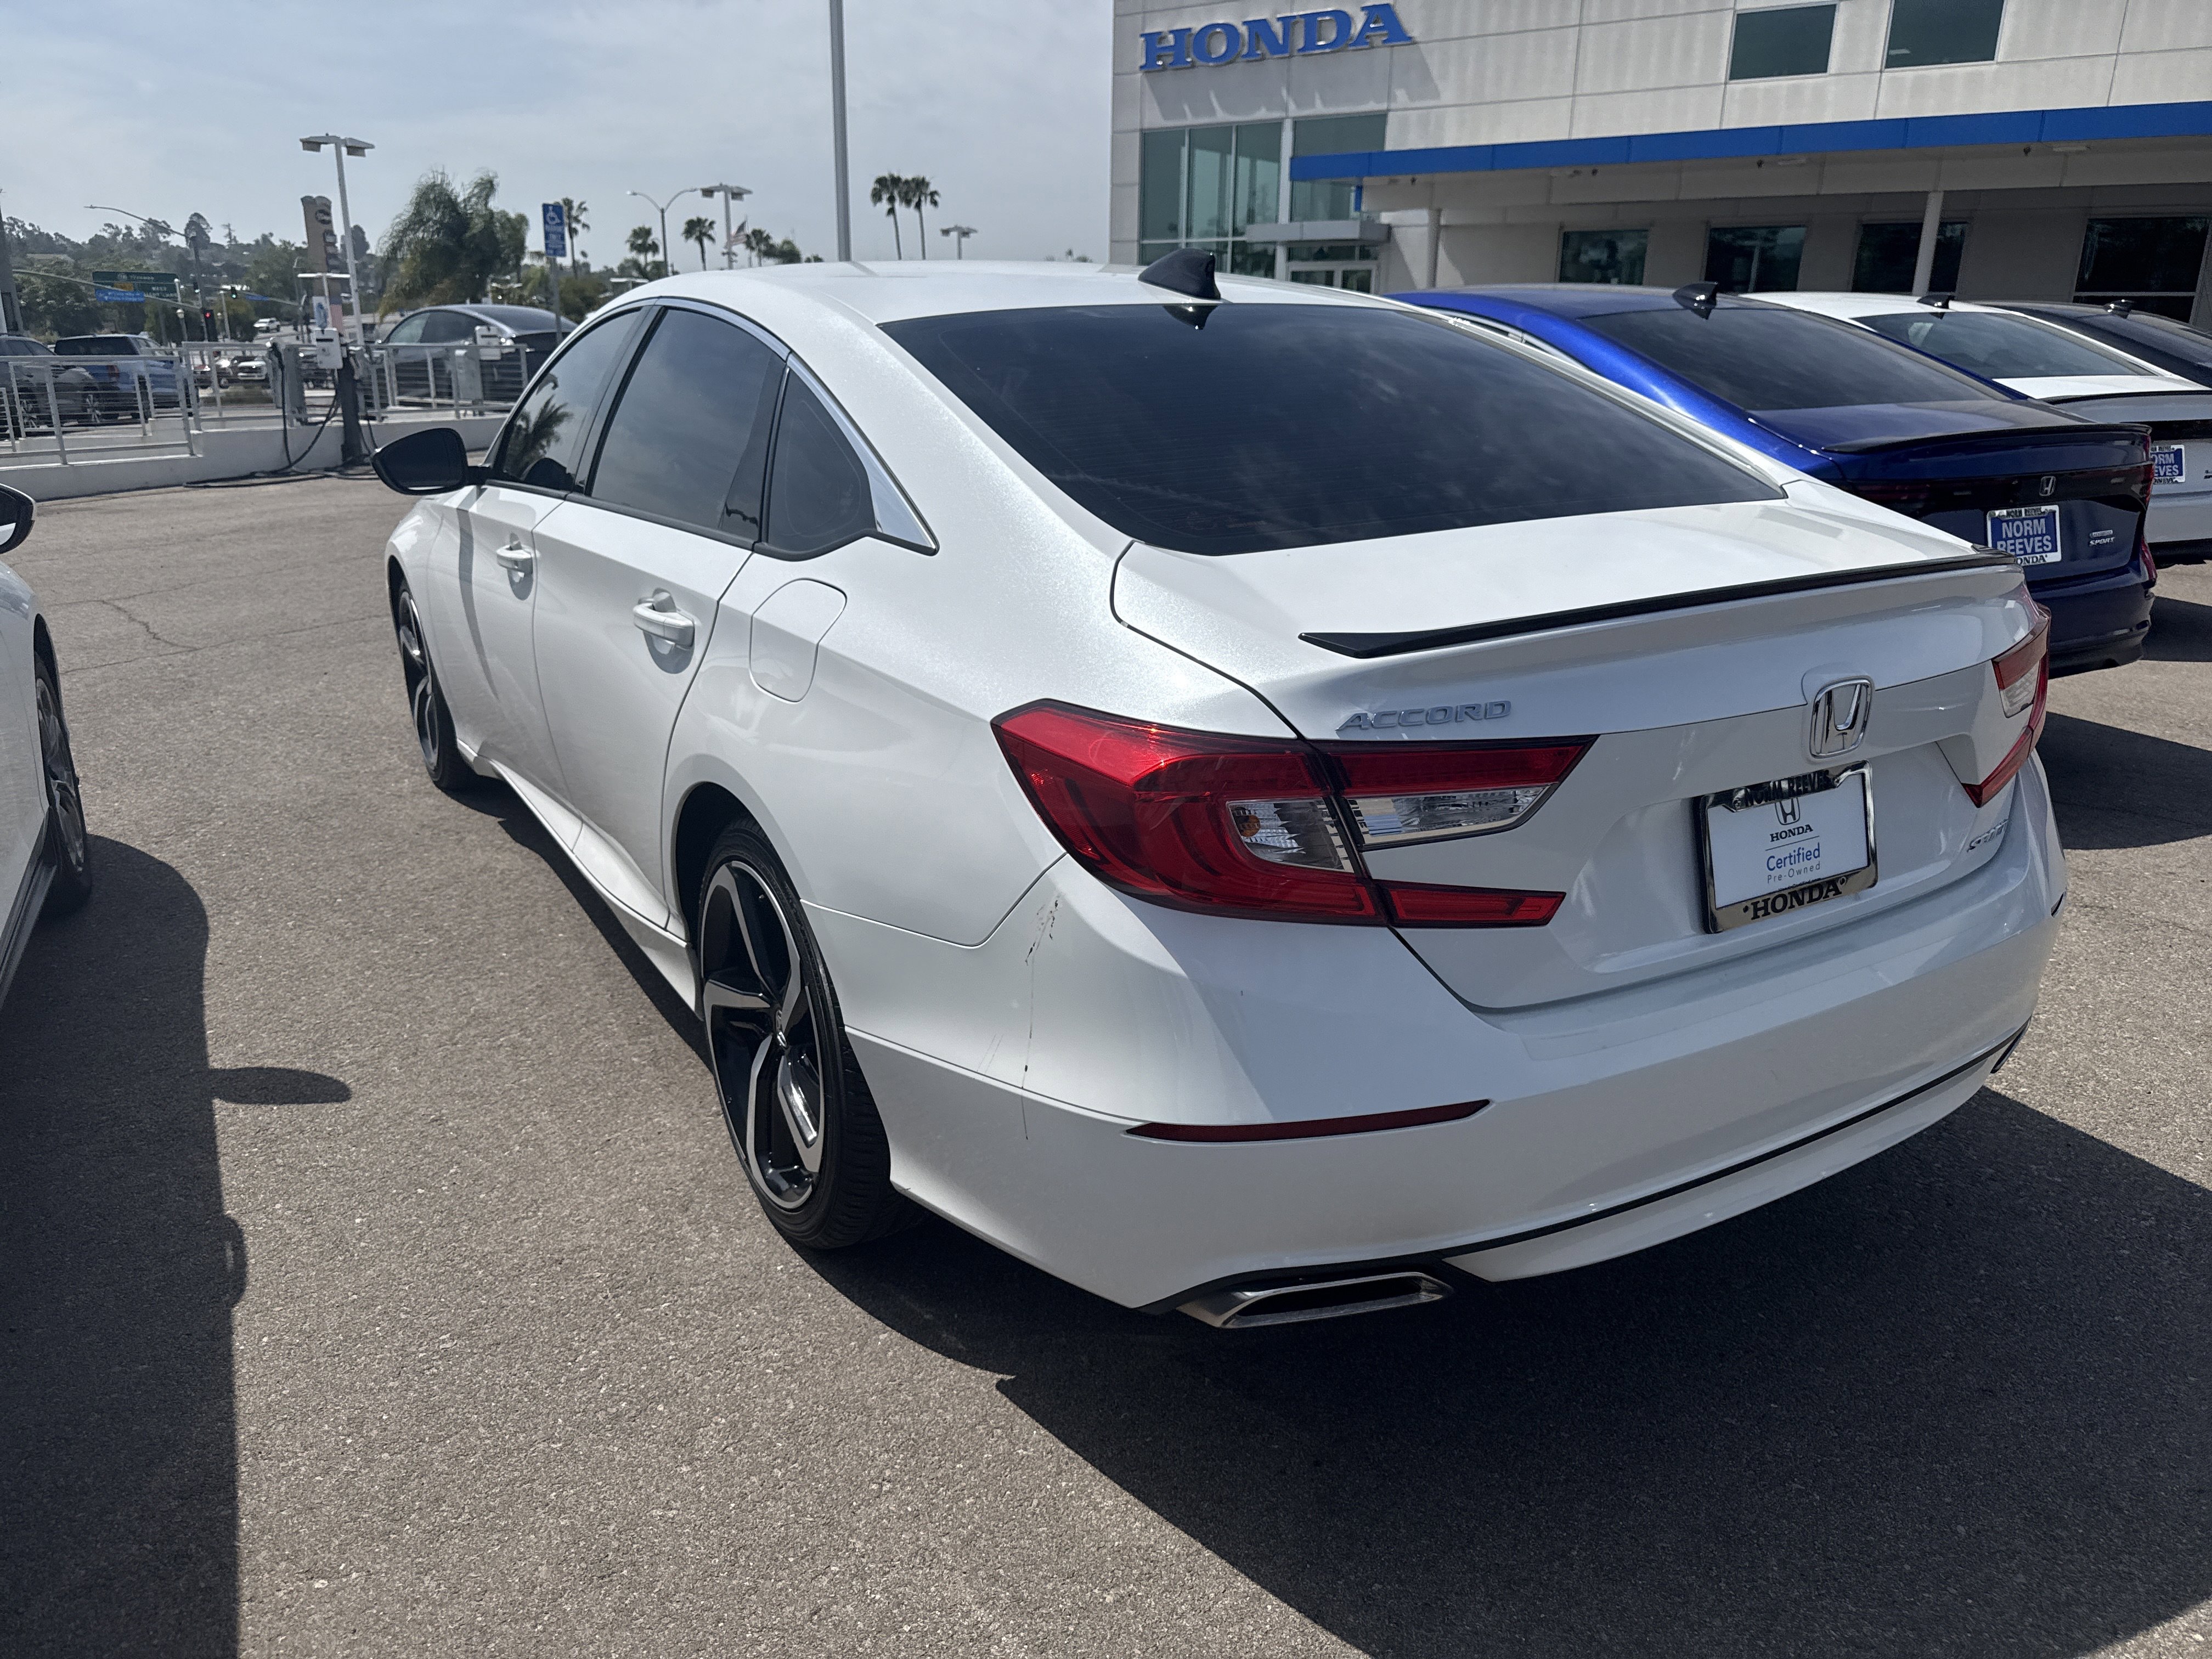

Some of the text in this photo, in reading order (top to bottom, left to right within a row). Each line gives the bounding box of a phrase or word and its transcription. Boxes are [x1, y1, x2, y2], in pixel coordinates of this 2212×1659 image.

[1139, 3, 1413, 71] HONDA
[2151, 453, 2175, 464] ORM
[2154, 465, 2179, 476] EVES
[2002, 518, 2046, 539] NORM
[2089, 537, 2115, 547] SPORT
[2015, 554, 2047, 565] ONDA
[1335, 700, 1512, 731] ACCORD
[1787, 769, 1830, 798] REEVES
[1770, 824, 1814, 842] HONDA
[1767, 842, 1820, 871] Certified
[1767, 861, 1821, 884] Pre-Owned
[1751, 878, 1842, 921] HONDA
